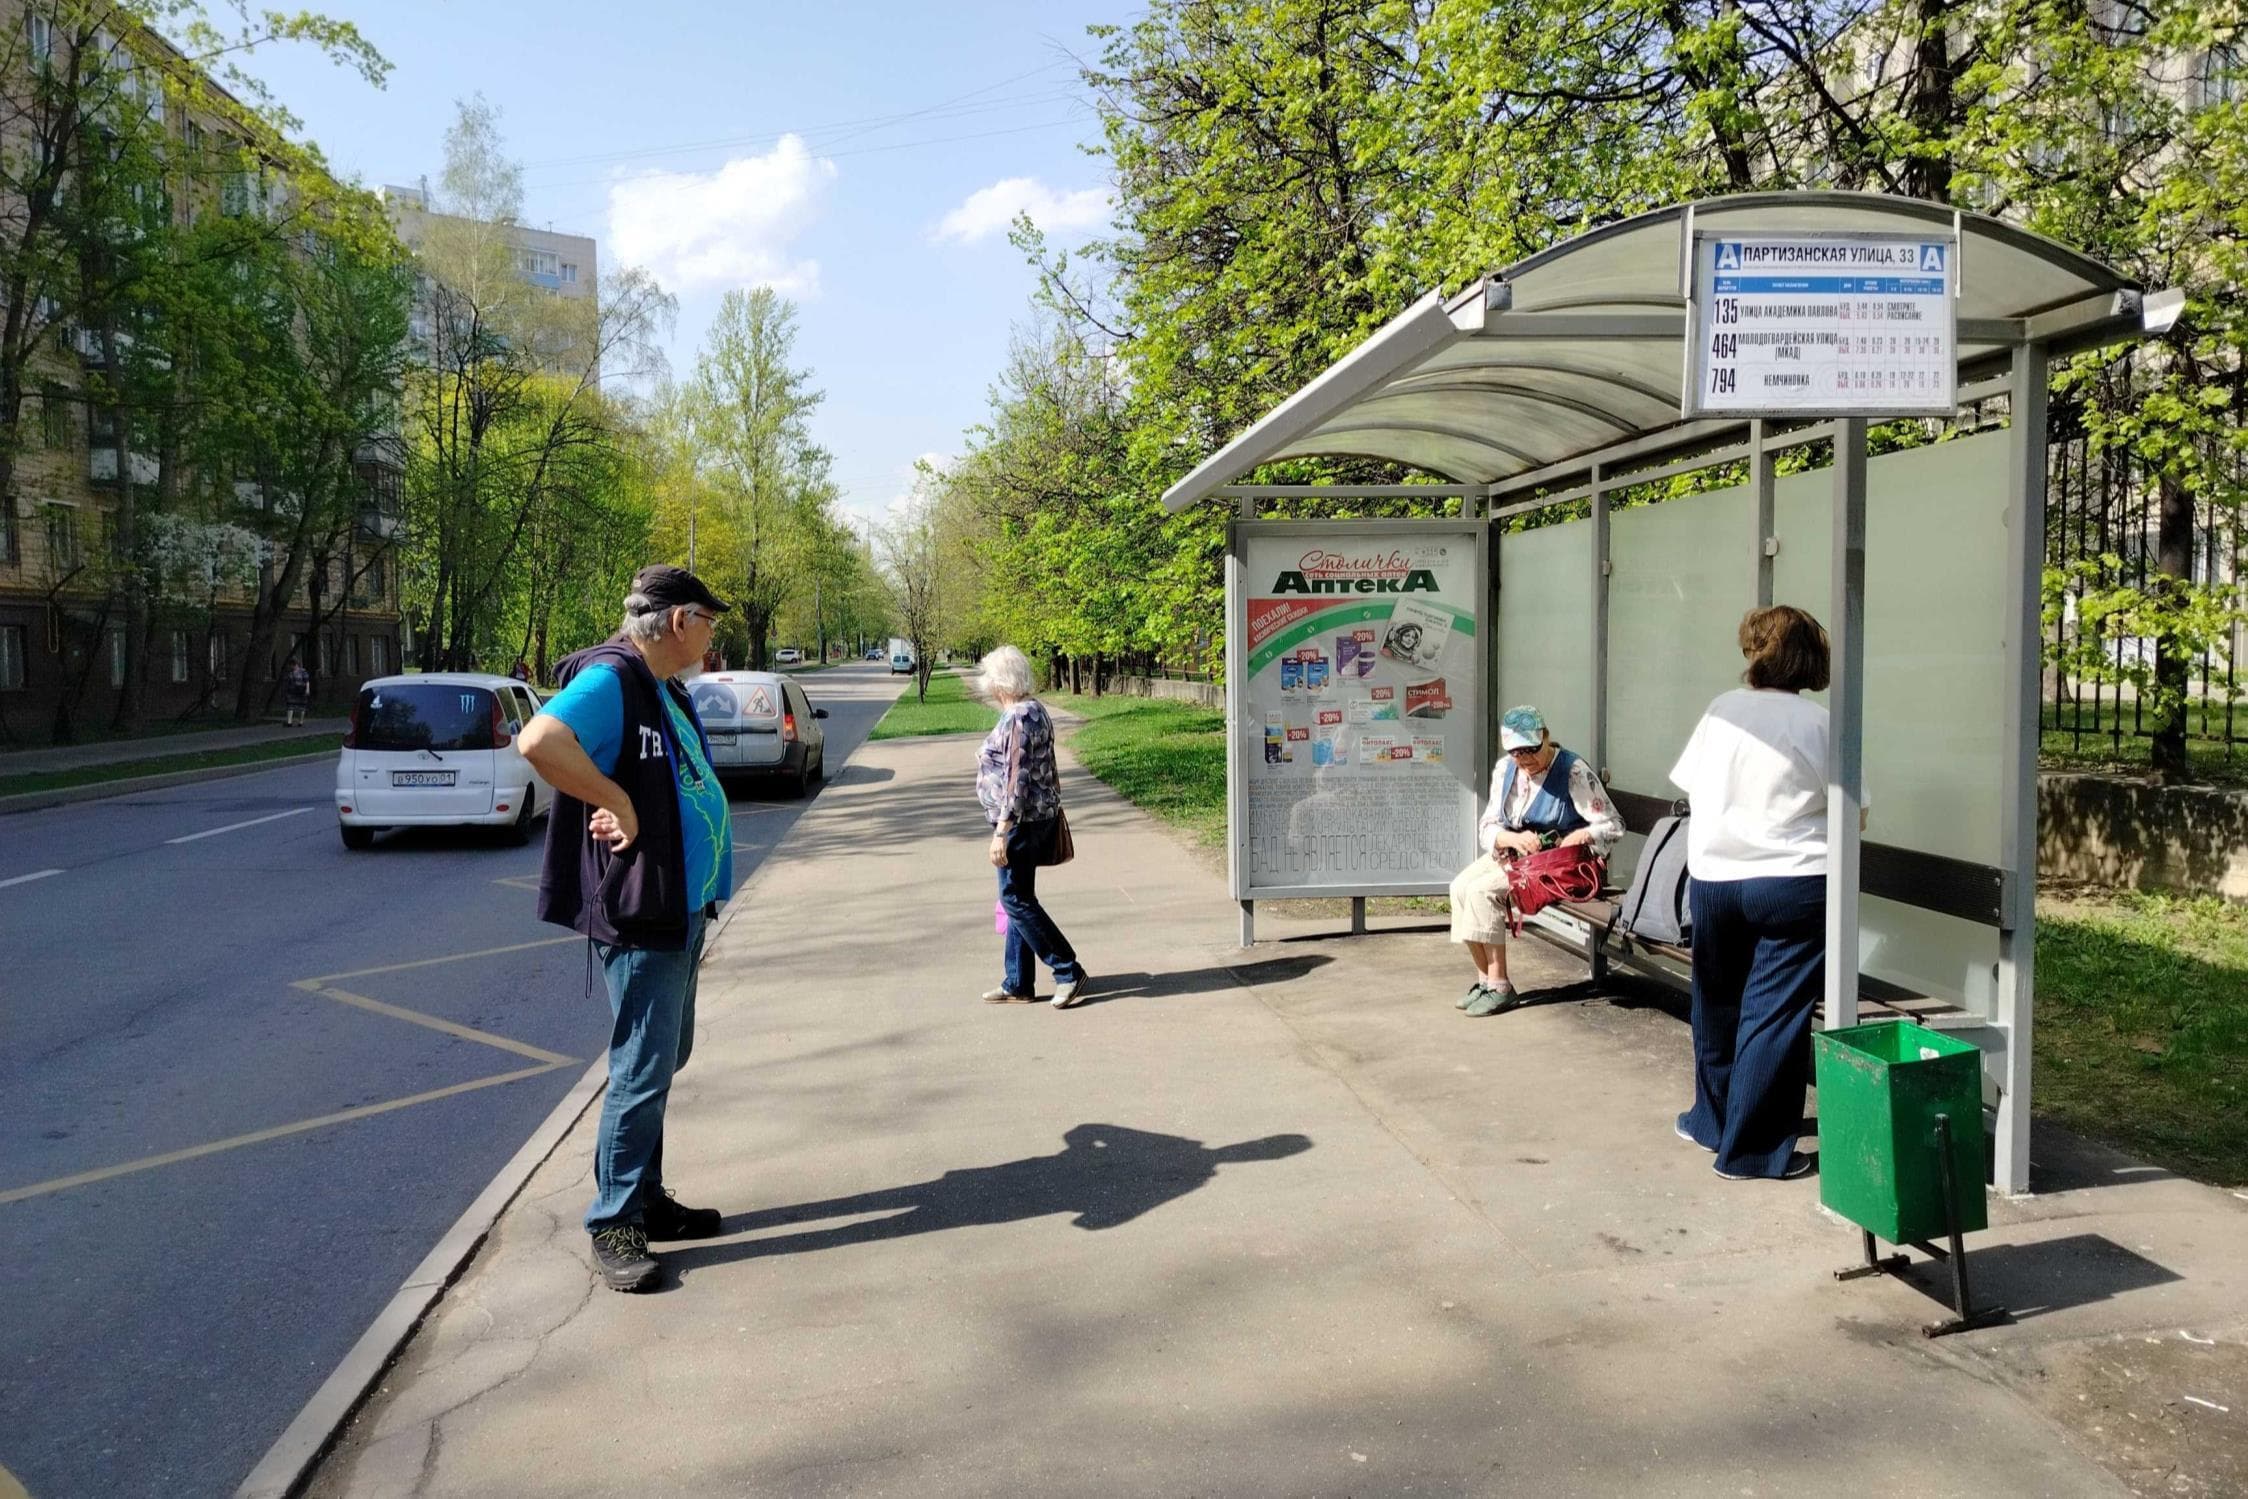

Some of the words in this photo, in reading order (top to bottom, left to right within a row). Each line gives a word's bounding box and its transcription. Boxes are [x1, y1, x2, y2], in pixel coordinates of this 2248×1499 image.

[1743, 246, 1847, 262] ПАРТИЗАНСКАЯ
[1850, 247, 1896, 265] УЛИЦА,
[1899, 248, 1914, 264] 33
[1714, 298, 1739, 324] 135
[1740, 305, 1762, 319] УЛИЦА
[1763, 305, 1807, 319] АКАДЕМИКА
[1807, 305, 1838, 318] ПАВЛОВА
[1712, 333, 1737, 359] 464
[1738, 331, 1815, 346] МОЛОДОГВАРДЕЙСКАЯ
[1816, 333, 1838, 347] УЛИЦА
[1775, 346, 1801, 361] (МКАД)
[1711, 368, 1736, 394] 794
[1763, 374, 1810, 387] НЕМЧИНОВКА
[1298, 549, 1413, 571] Столички
[1251, 601, 1292, 632] ПОЕХАЛИ!
[1354, 631, 1373, 642] -20%
[1298, 651, 1317, 661] -20%
[1372, 688, 1391, 699] -20%
[1320, 712, 1340, 723] -20%
[638, 724, 669, 760] TR
[1288, 729, 1307, 740] -20%
[1391, 748, 1411, 758] -20%
[1250, 836, 1280, 873] БАД
[1303, 834, 1367, 872] ЯВЛЯЕТСЯ
[1369, 850, 1462, 872] СРЕДСТВОМ
